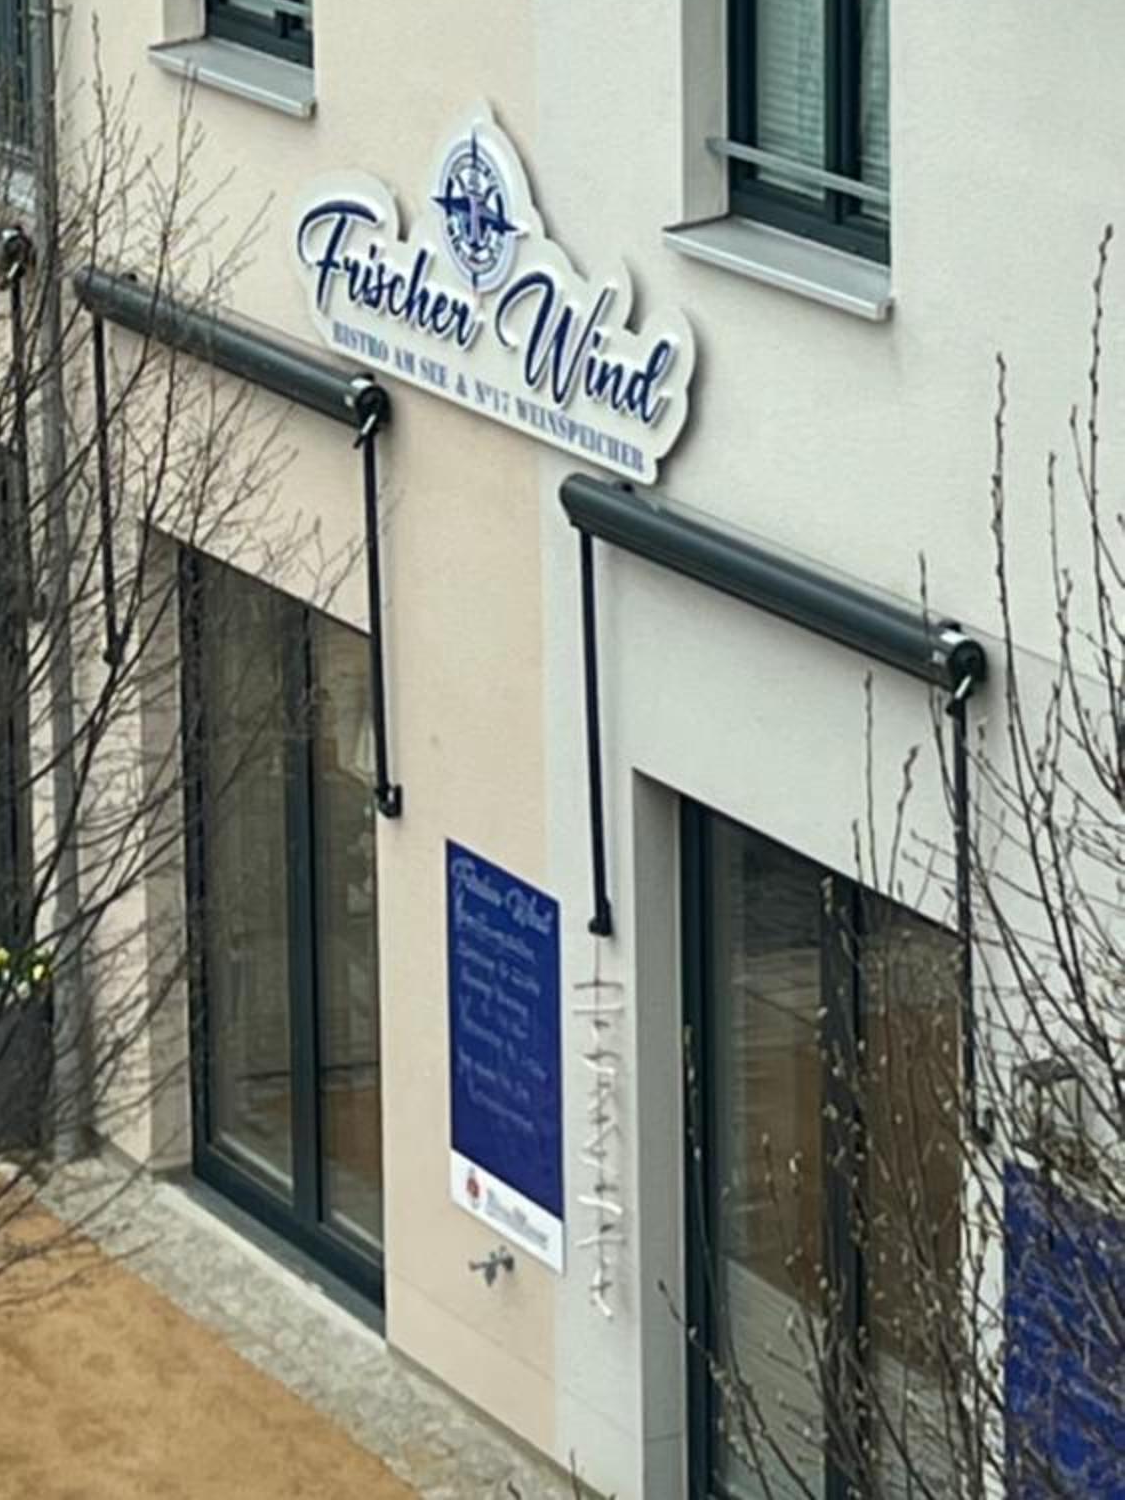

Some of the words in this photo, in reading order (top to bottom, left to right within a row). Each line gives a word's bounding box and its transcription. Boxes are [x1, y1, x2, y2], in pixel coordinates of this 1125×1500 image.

[297, 200, 470, 347] Frischer
[494, 271, 671, 424] Wind
[333, 321, 389, 362] BISTRO
[394, 348, 415, 375] AM
[420, 358, 447, 389] SEE
[456, 372, 468, 397] &
[516, 396, 645, 474] WEINSPEICHER
